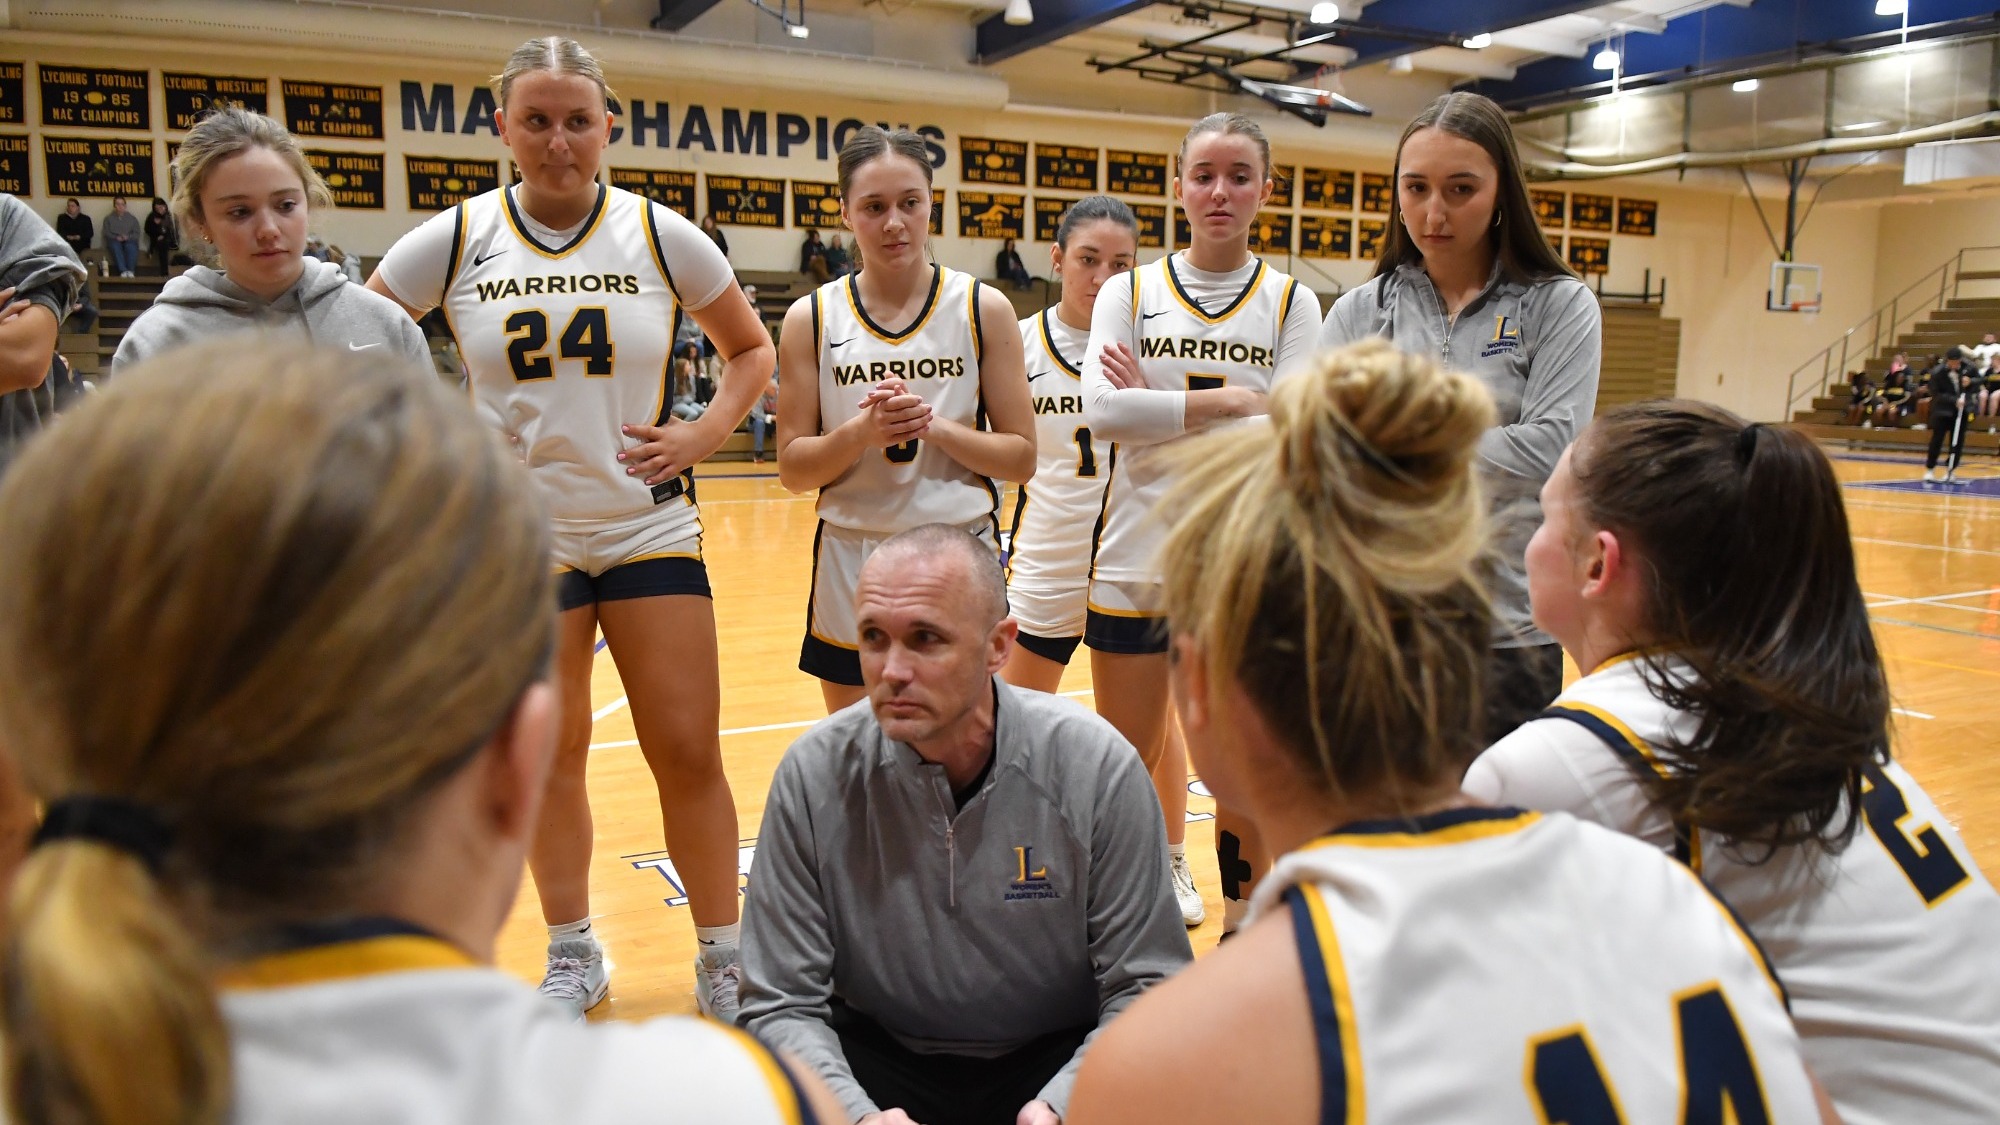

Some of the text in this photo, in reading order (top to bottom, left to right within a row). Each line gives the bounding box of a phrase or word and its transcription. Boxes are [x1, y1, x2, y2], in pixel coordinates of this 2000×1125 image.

[43, 70, 145, 89] LYCOMING FOOTBALL
[164, 76, 267, 94] LYCOMING WRESTLING
[63, 91, 131, 106] 19 85
[283, 83, 380, 102] LYCOMING WRESTLING
[191, 96, 203, 109] 19
[400, 81, 503, 137] MA
[52, 107, 140, 124] MAC CHAMPIONS
[296, 120, 374, 136] MAC CHAMPIONS
[45, 140, 152, 157] LYCOMING WRESTLING
[0, 159, 10, 172] 4
[69, 161, 86, 174] 19
[336, 157, 380, 172] FOOTBALL
[409, 161, 496, 177] LYCOMING FOOTBALL
[58, 180, 146, 195] MAC CHAMPIONS
[333, 191, 375, 205] AMPIONS
[418, 193, 436, 205] MAC
[476, 274, 640, 302] WARRIORS
[503, 306, 616, 384] 24
[832, 356, 964, 387] WARRIORS
[1013, 846, 1047, 884] L
